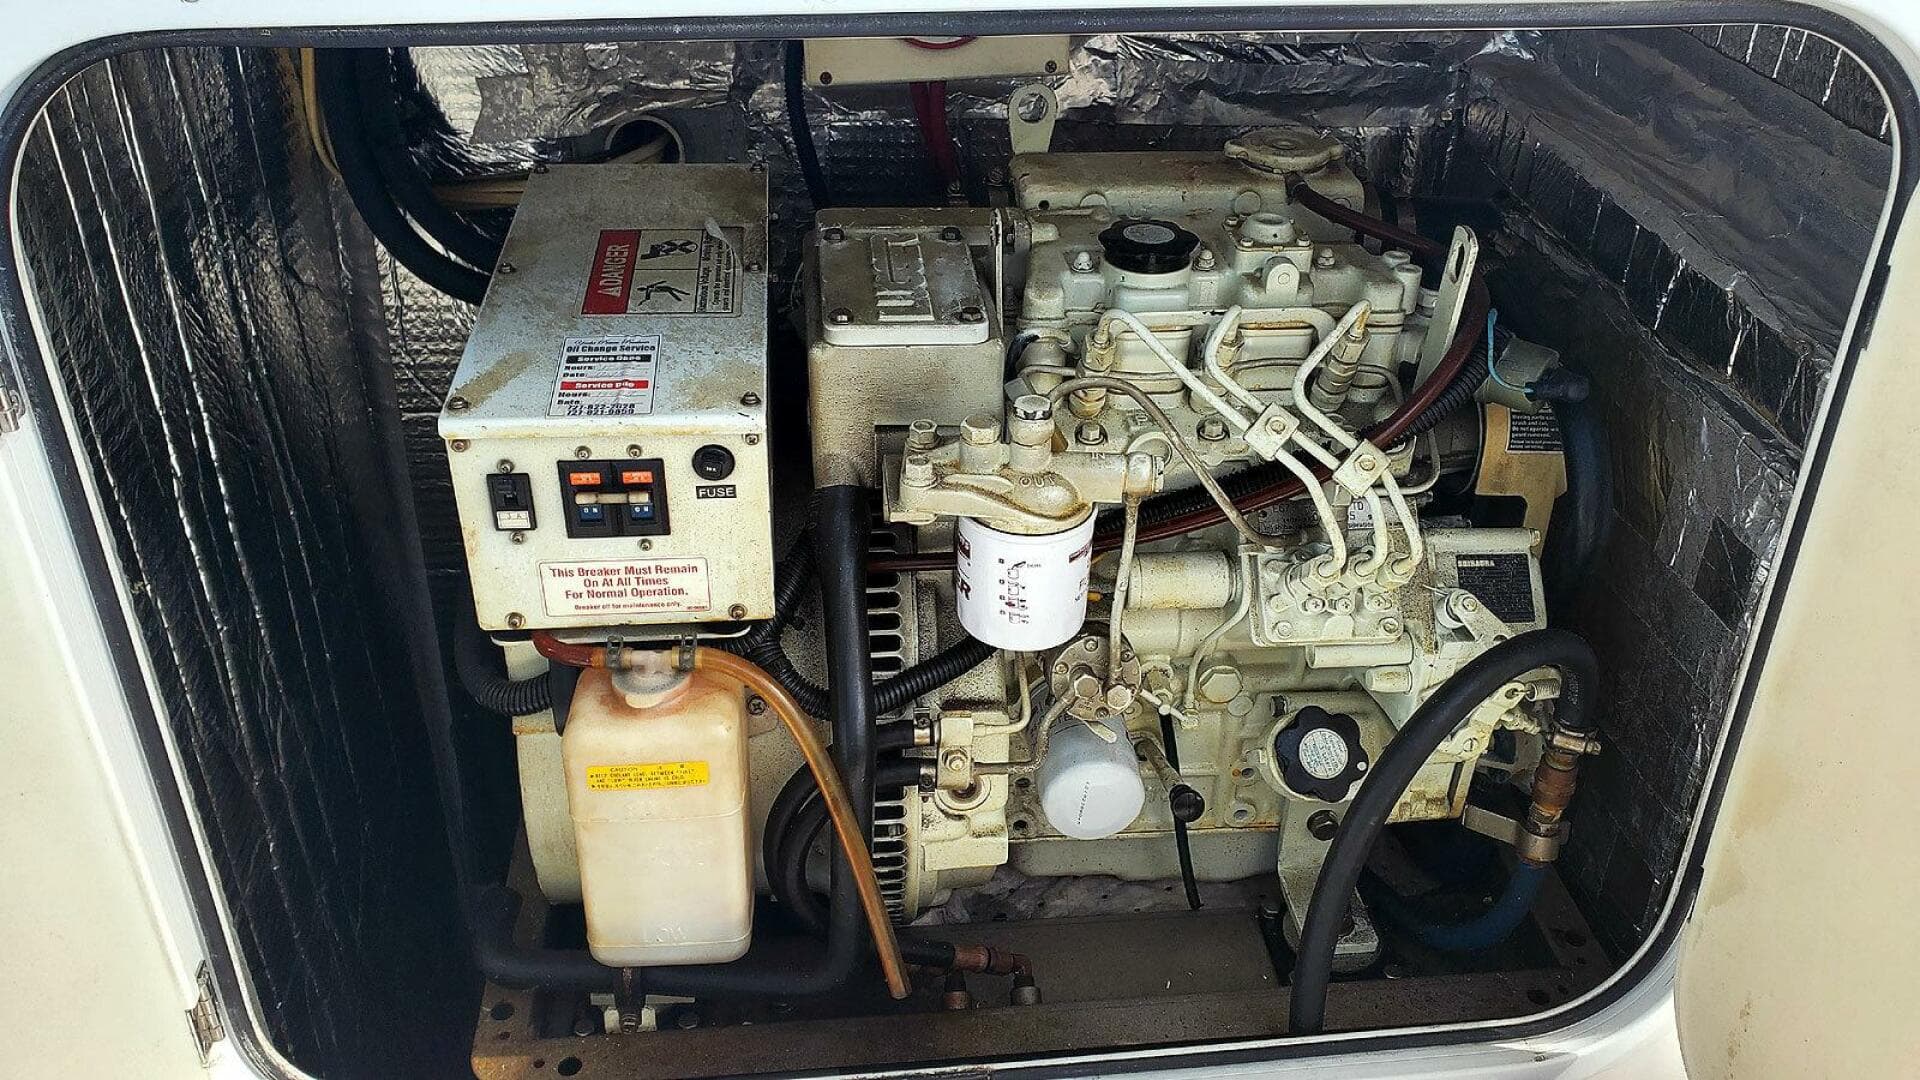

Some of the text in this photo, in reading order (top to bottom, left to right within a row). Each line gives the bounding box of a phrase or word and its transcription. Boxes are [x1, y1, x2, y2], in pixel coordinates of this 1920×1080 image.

[600, 244, 630, 286] DANGER
[582, 345, 617, 353] Change
[1020, 475, 1056, 488] OUT
[698, 487, 734, 497] FUSE
[550, 564, 698, 578] This Breaker Must Remain
[583, 576, 669, 588] On At All Times
[565, 586, 689, 599] For Normal Operation.
